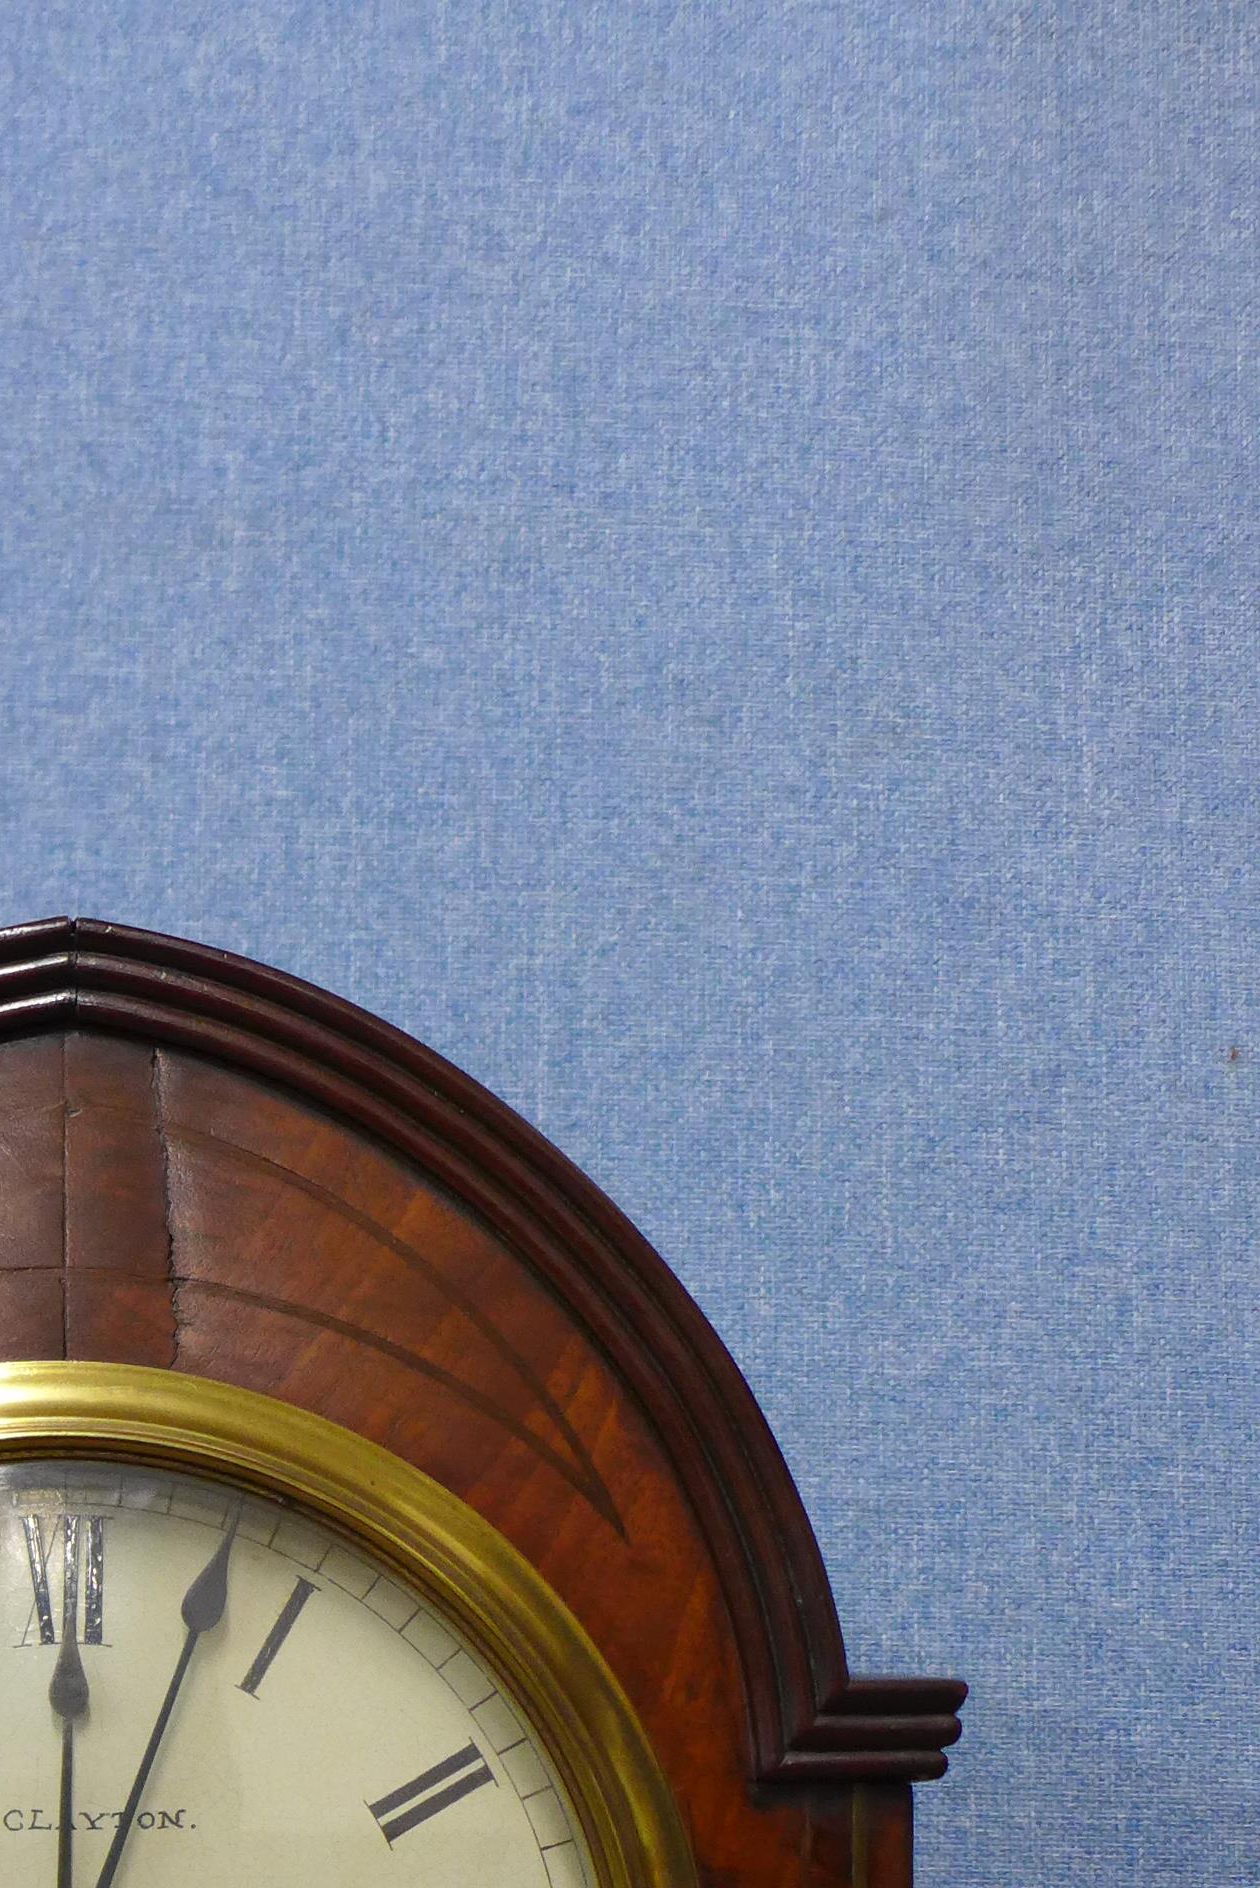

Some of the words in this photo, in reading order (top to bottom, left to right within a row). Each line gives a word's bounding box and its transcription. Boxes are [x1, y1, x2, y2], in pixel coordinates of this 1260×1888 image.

[234, 1575, 322, 1700] I
[2, 1808, 198, 1832] CLYTON.
[363, 1736, 500, 1851] II
